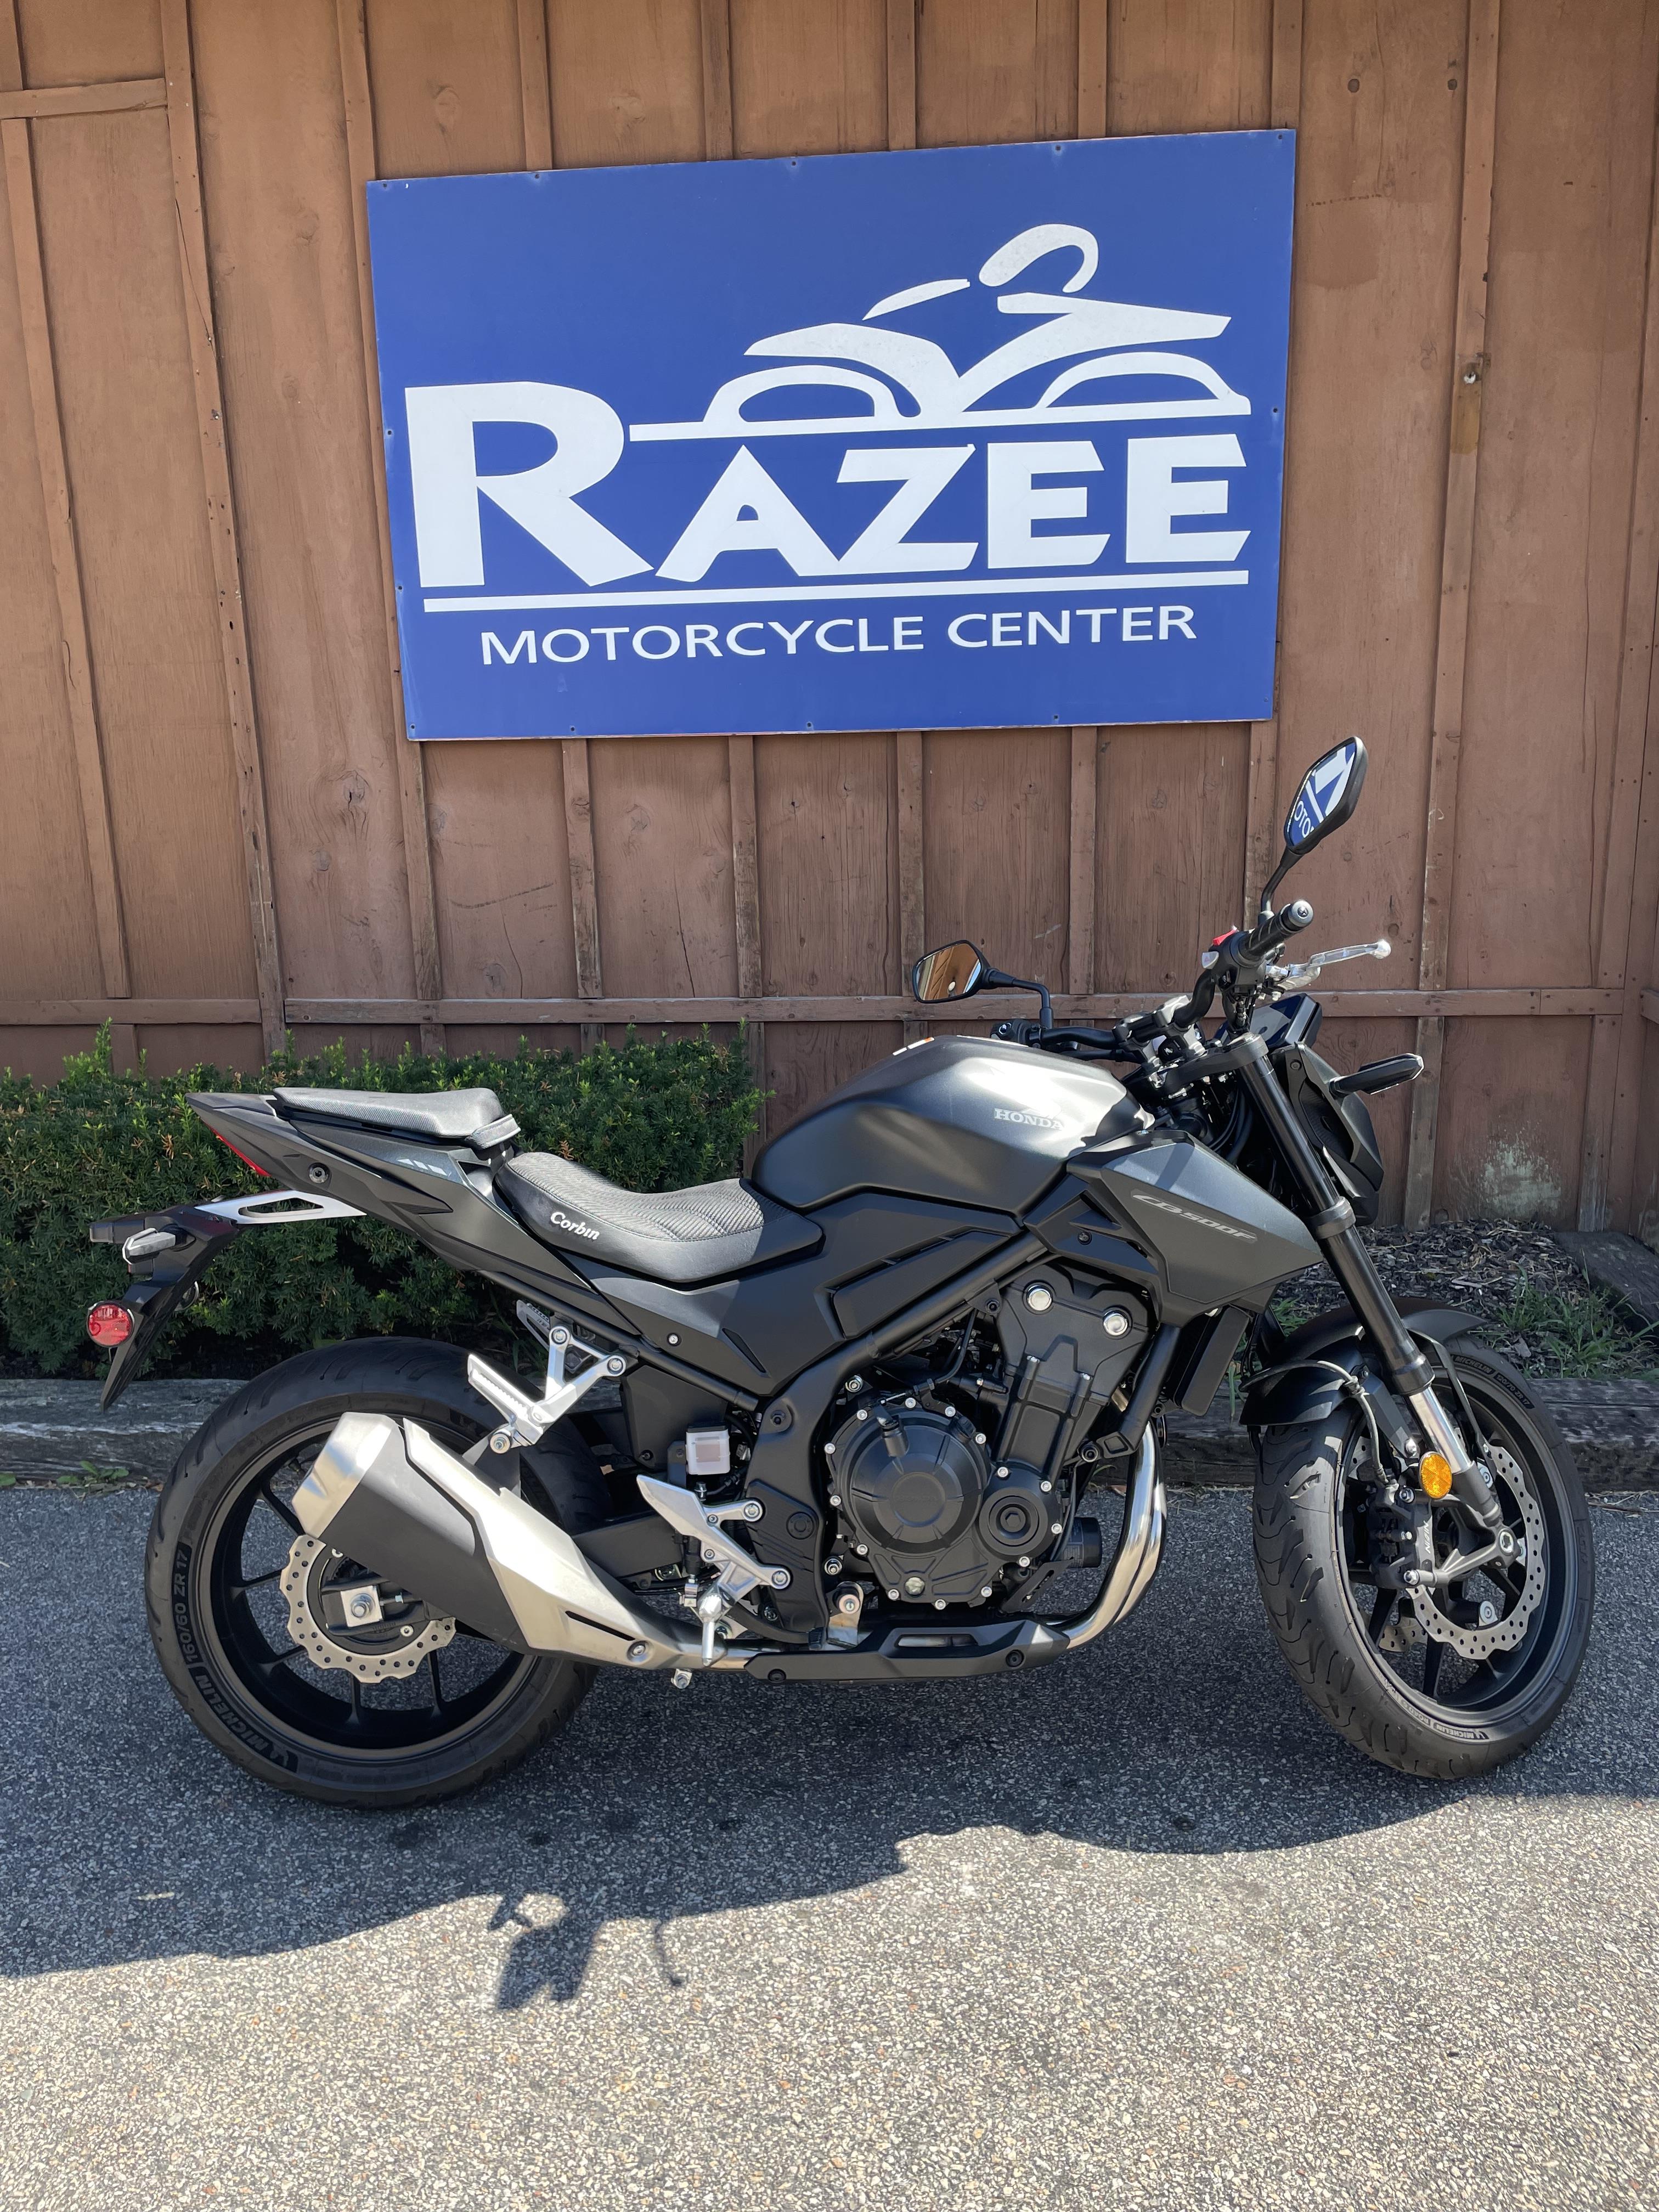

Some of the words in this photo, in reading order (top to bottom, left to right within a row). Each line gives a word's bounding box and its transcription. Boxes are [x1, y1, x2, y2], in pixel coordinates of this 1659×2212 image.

[404, 381, 1252, 588] RAZEE
[481, 616, 924, 665] MOTORCYCLE
[947, 605, 1198, 648] CENTER
[994, 1108, 1065, 1131] HONDA
[550, 1211, 600, 1240] Corbin
[1455, 1355, 1493, 1374] MICHELIN
[176, 1549, 188, 1568] 17
[174, 1572, 185, 1597] ZR
[174, 1602, 198, 1662] 160/60
[195, 1674, 270, 1751] MICHELIN
[1436, 1723, 1475, 1739] MICHELIN
